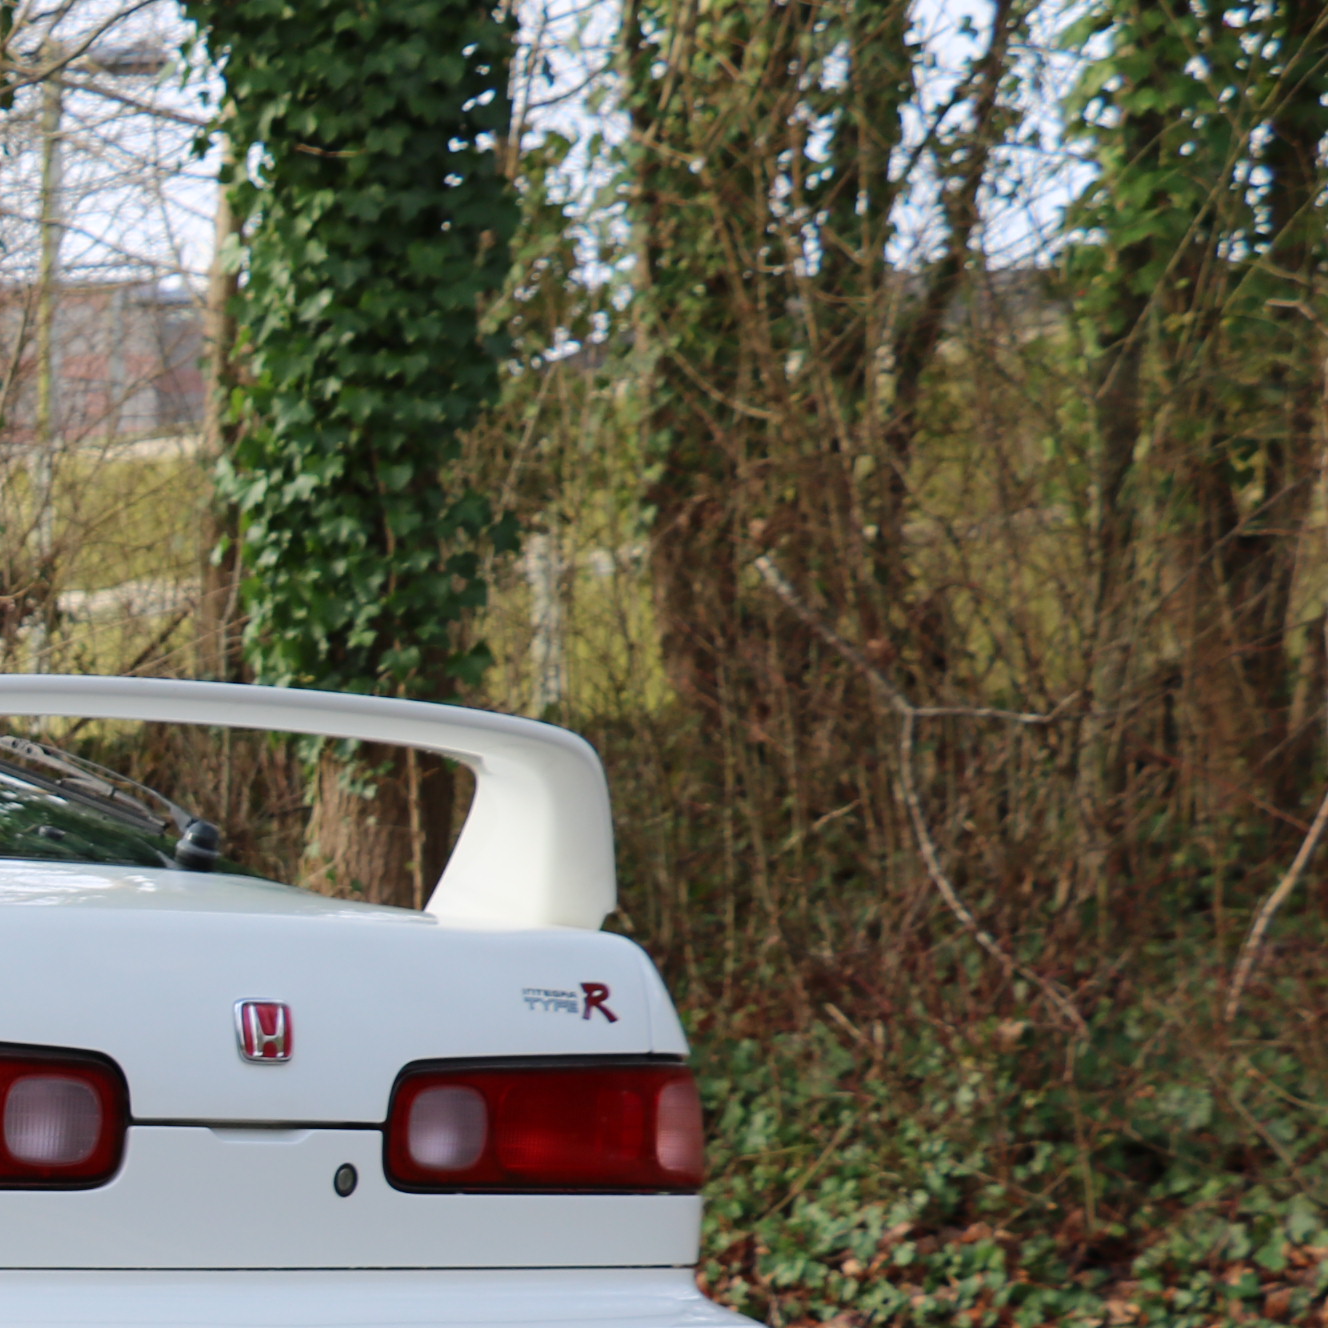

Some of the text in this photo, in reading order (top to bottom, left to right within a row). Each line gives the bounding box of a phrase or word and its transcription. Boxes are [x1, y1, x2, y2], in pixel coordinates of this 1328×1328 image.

[522, 988, 578, 998] INTEGRA
[524, 982, 618, 1023] TYPE R
